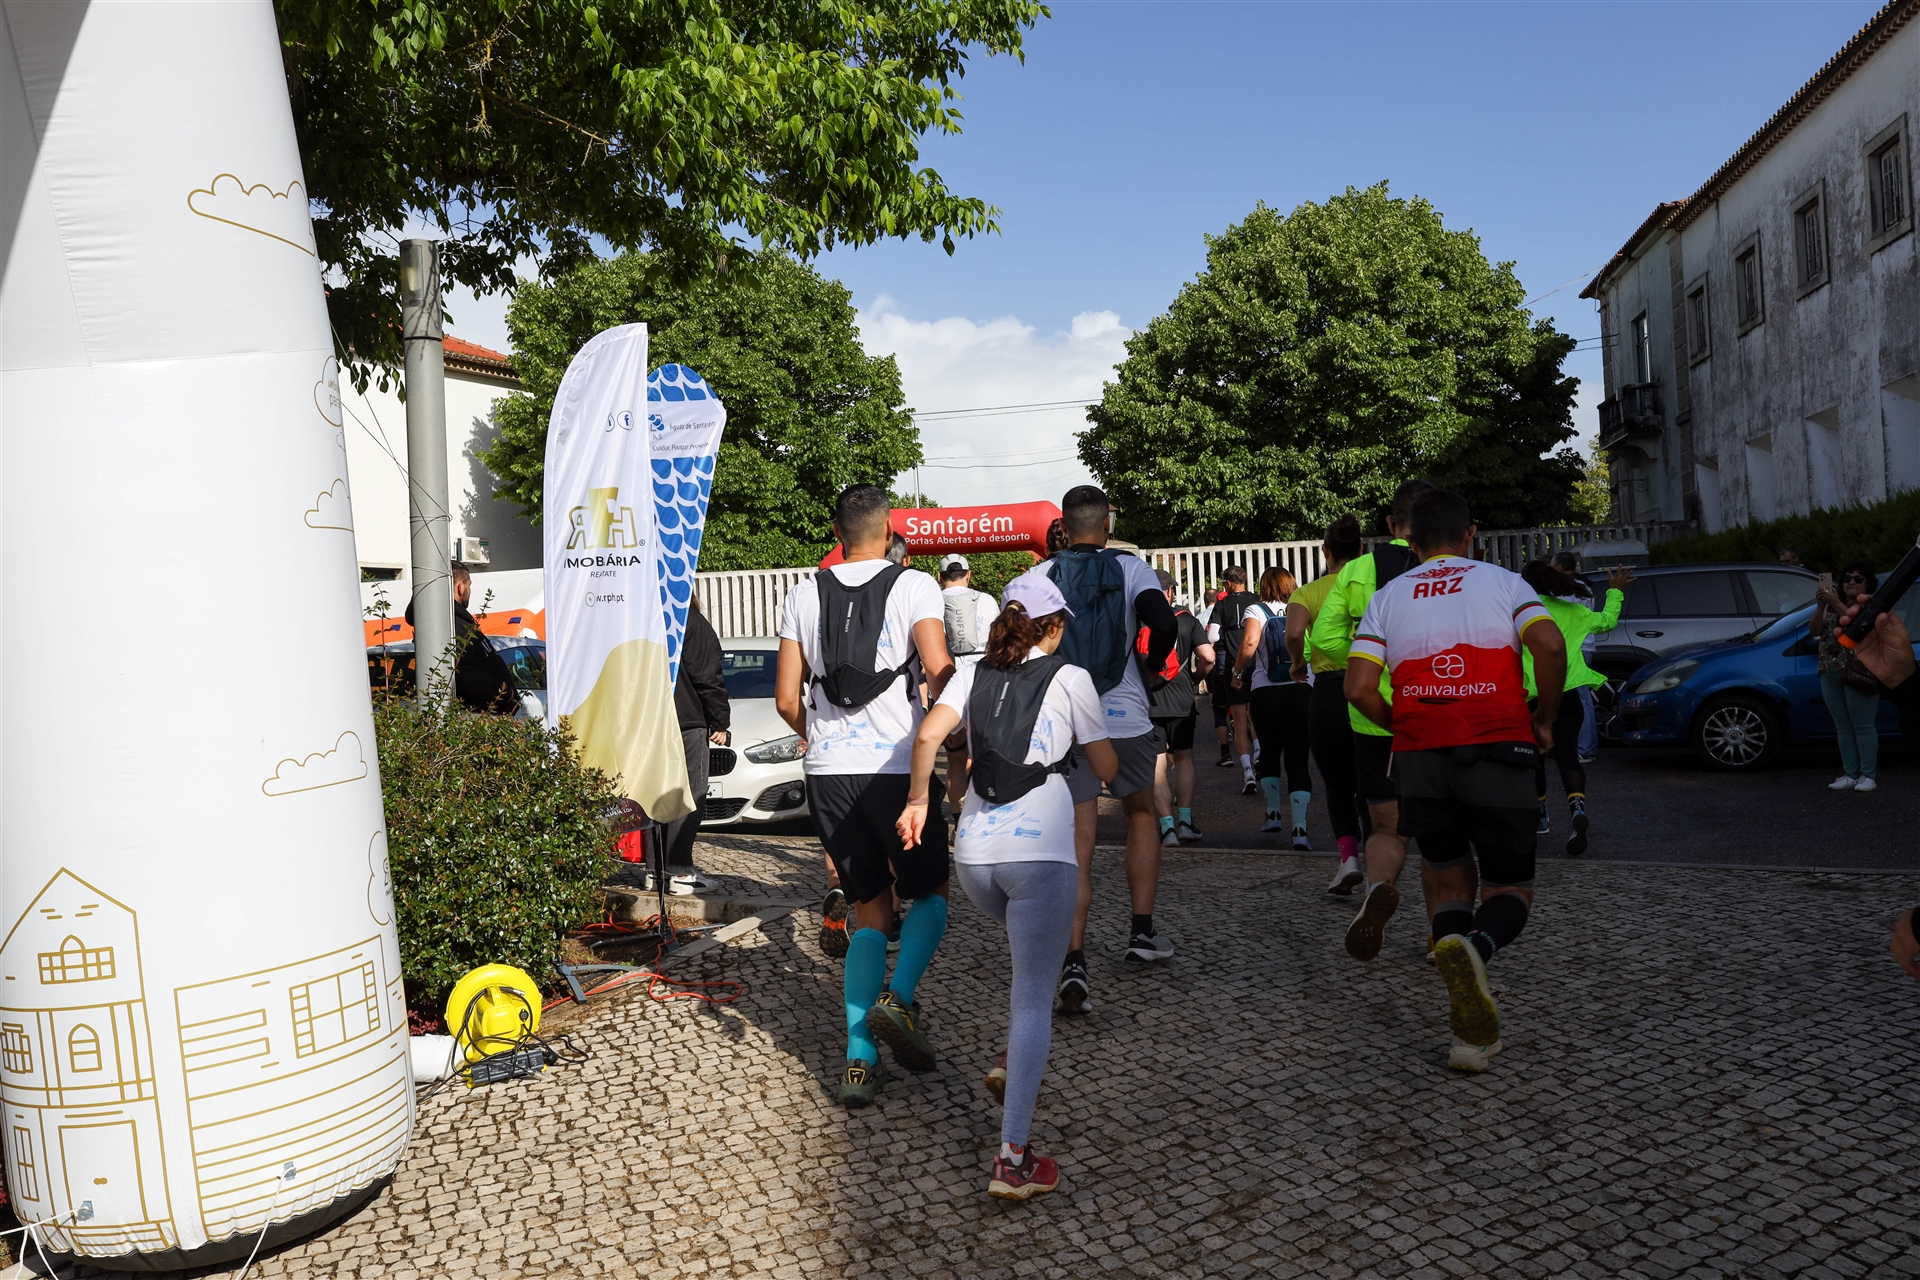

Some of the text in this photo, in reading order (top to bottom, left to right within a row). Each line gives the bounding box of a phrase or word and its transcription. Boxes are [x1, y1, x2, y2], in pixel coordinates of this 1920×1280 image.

[905, 512, 1014, 536] Santarém
[904, 532, 1031, 546] Portas Abertas ao desporto
[1413, 576, 1464, 600] ARZ
